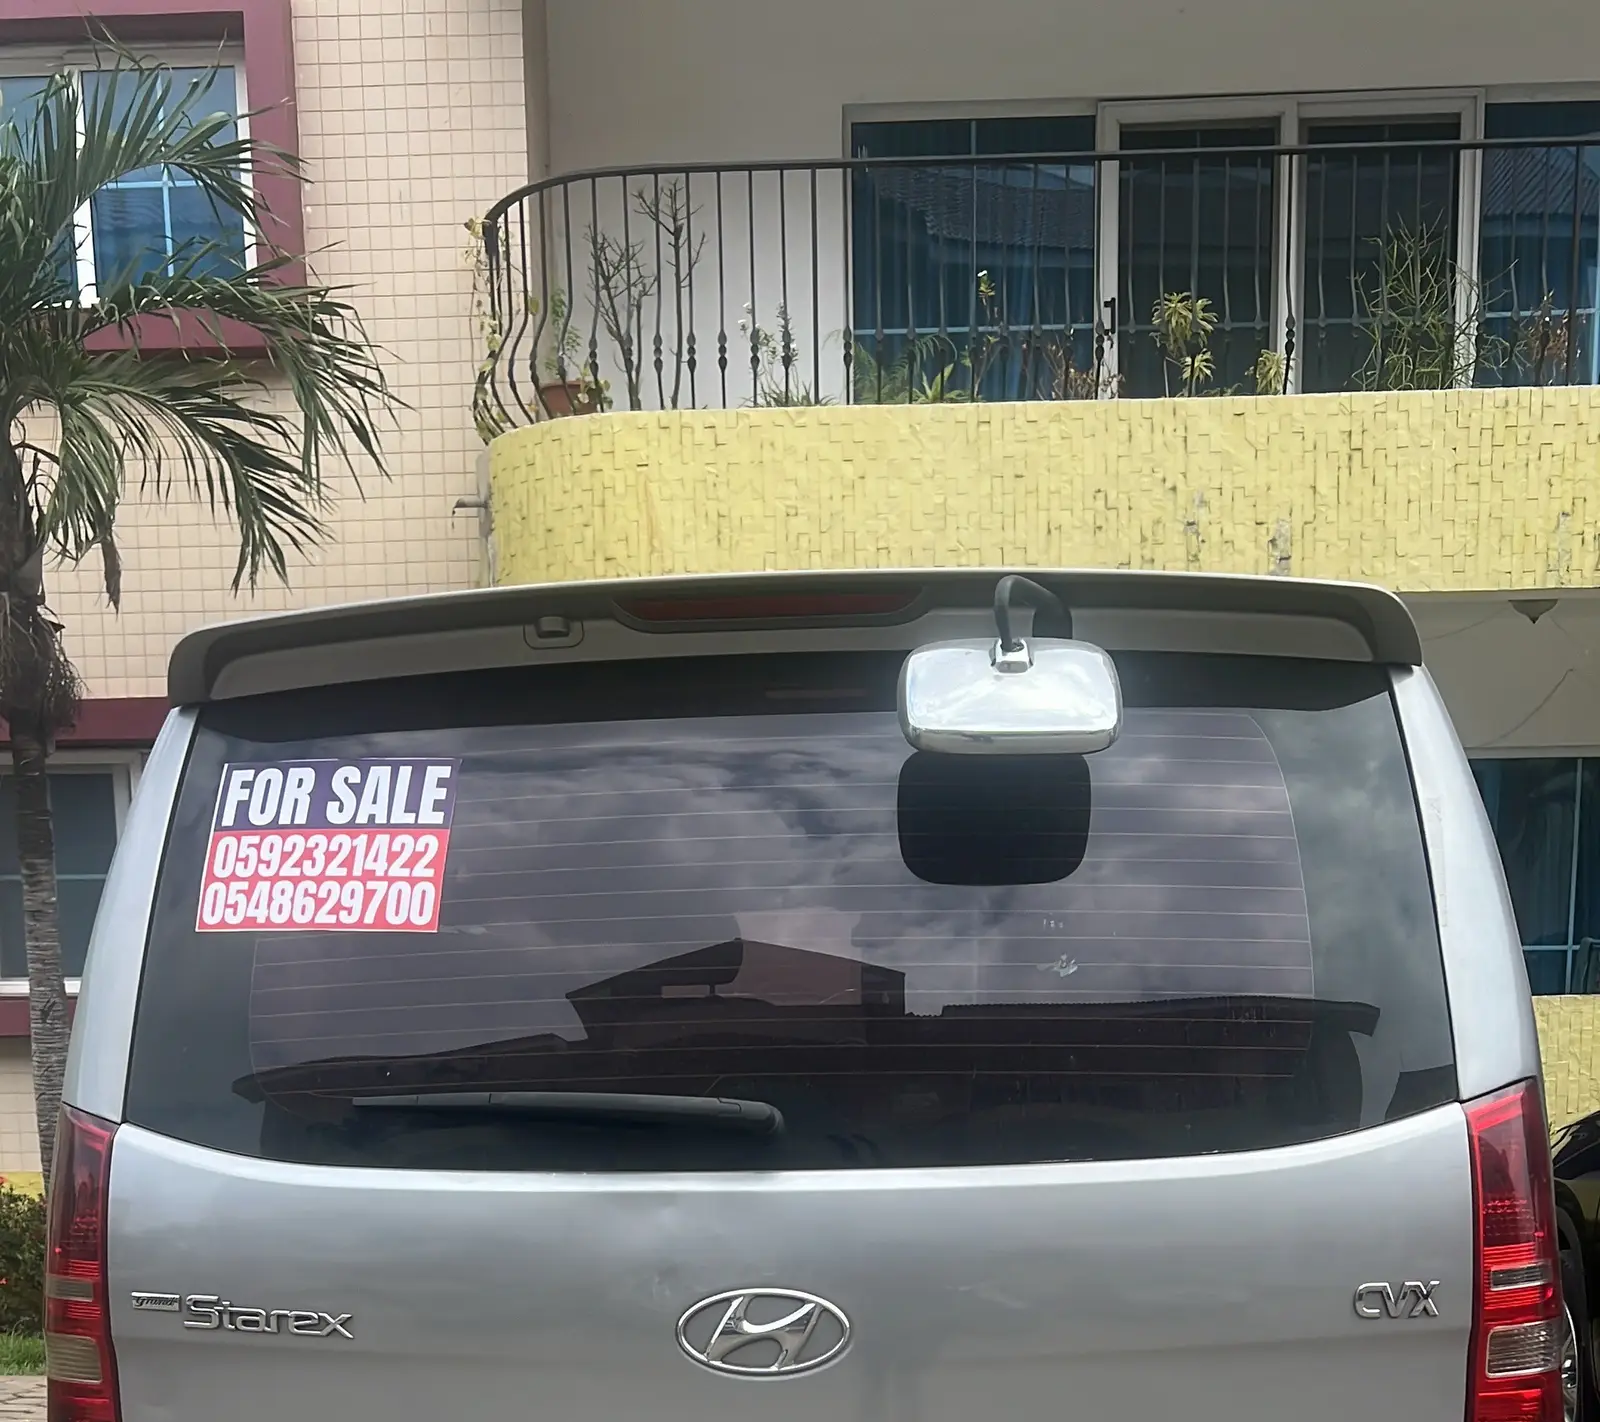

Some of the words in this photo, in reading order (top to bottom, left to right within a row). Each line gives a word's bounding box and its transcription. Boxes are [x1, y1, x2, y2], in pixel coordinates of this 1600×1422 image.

[221, 767, 316, 827] FOR
[326, 765, 452, 825] SALE
[213, 833, 439, 879] 0592321422
[202, 879, 436, 926] 0548629700
[184, 1294, 354, 1339] Starex
[1354, 1280, 1440, 1319] CVX
